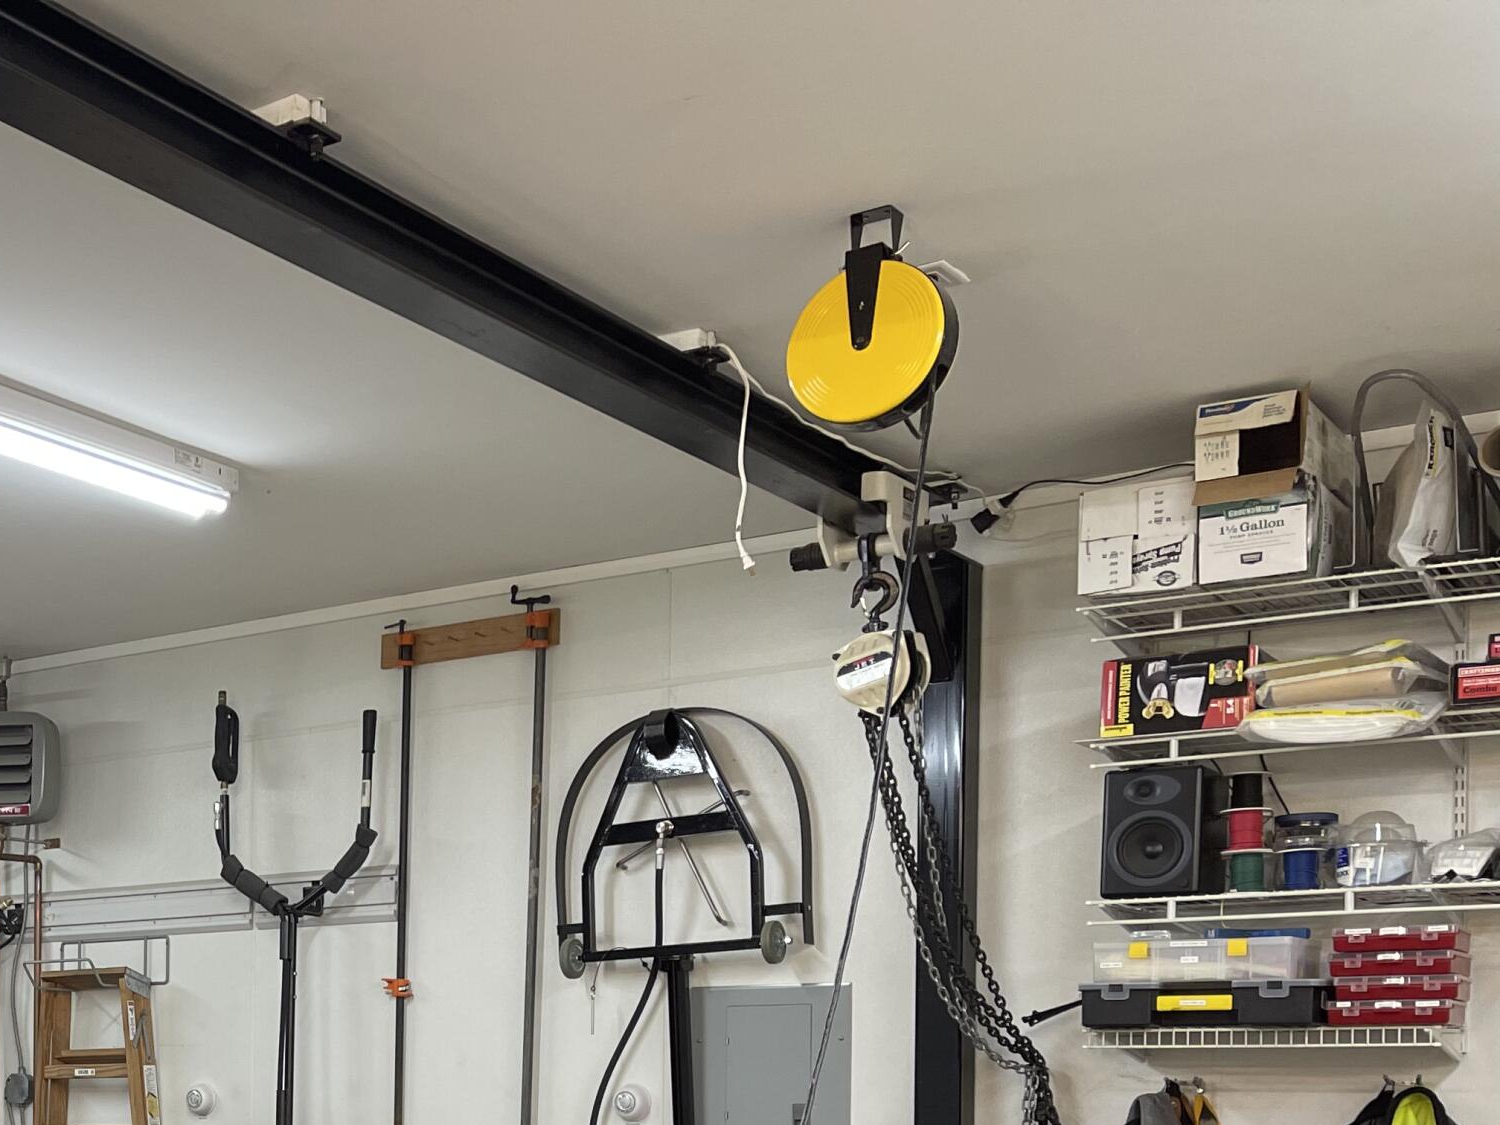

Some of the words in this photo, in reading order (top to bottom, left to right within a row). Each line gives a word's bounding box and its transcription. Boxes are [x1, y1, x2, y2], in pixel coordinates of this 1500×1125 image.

[1240, 518, 1285, 533] Gallon
[854, 658, 875, 670] JET
[1119, 664, 1132, 694] PAINTER
[1463, 683, 1498, 694] Combo
[1118, 695, 1130, 723] POWER
